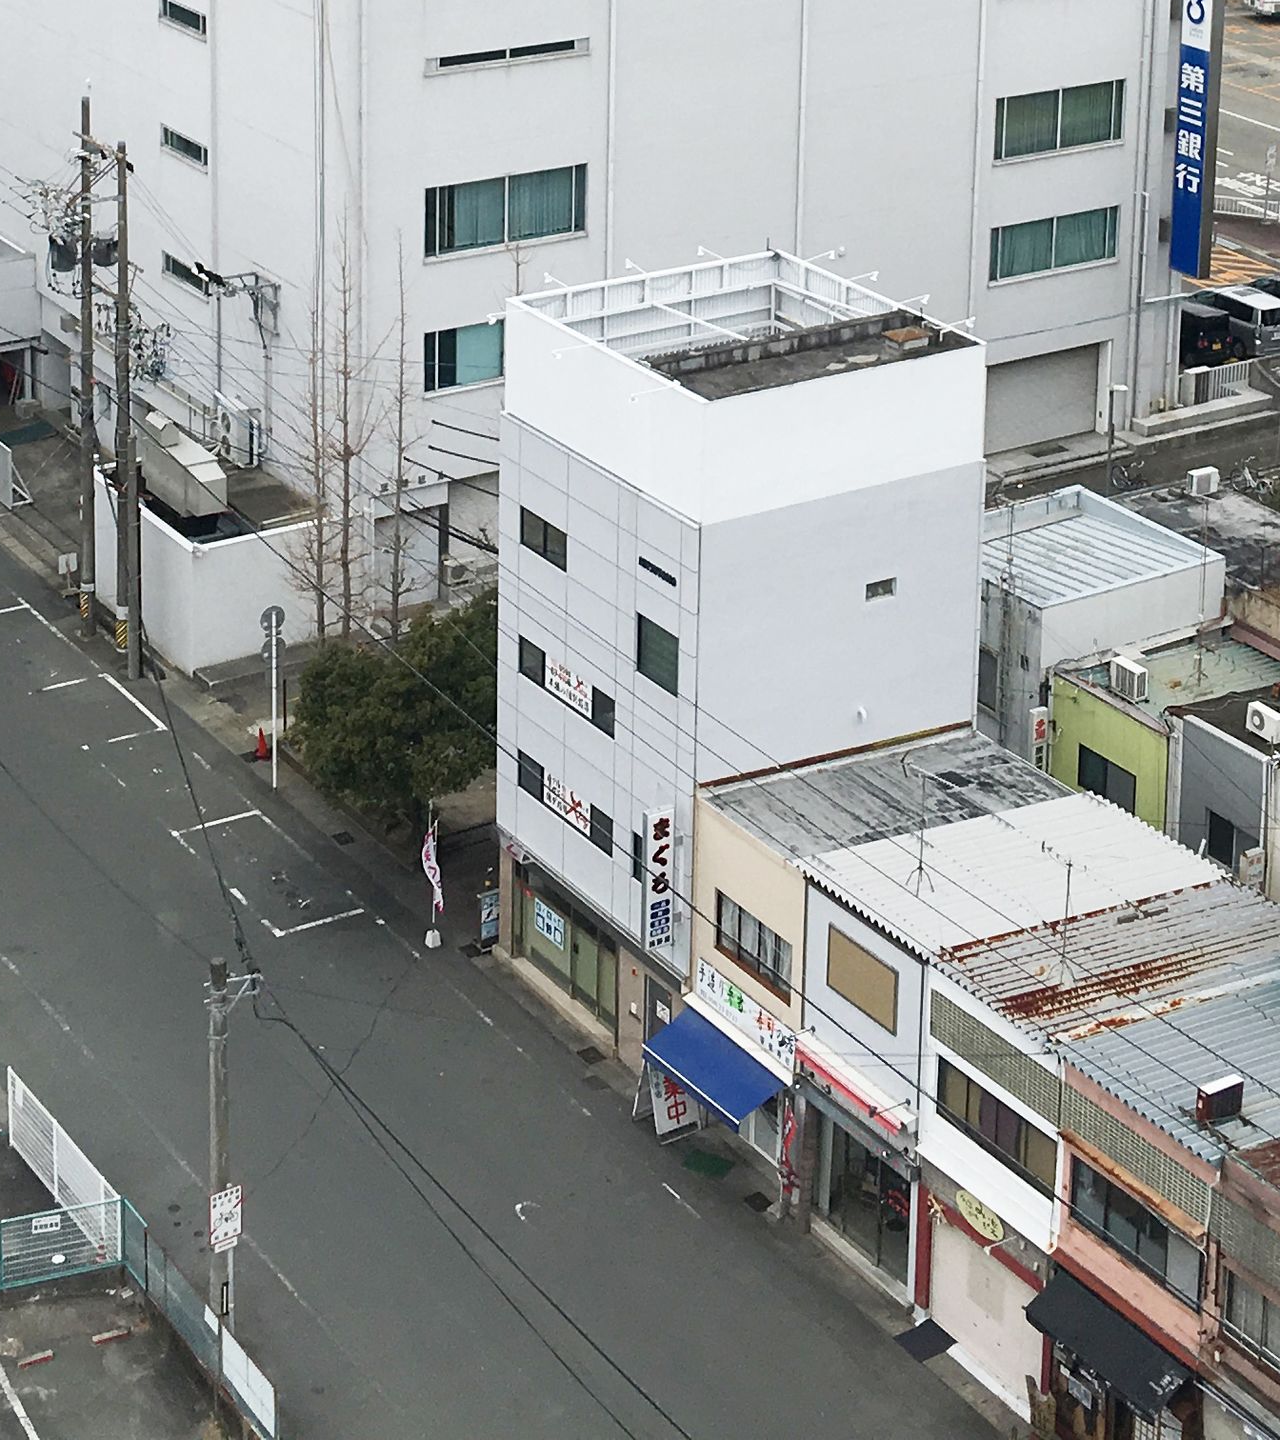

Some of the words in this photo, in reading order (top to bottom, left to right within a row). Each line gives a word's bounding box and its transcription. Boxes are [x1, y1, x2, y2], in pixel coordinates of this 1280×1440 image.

[1175, 61, 1206, 194] 第三銀行
[651, 817, 670, 894] まぐろ
